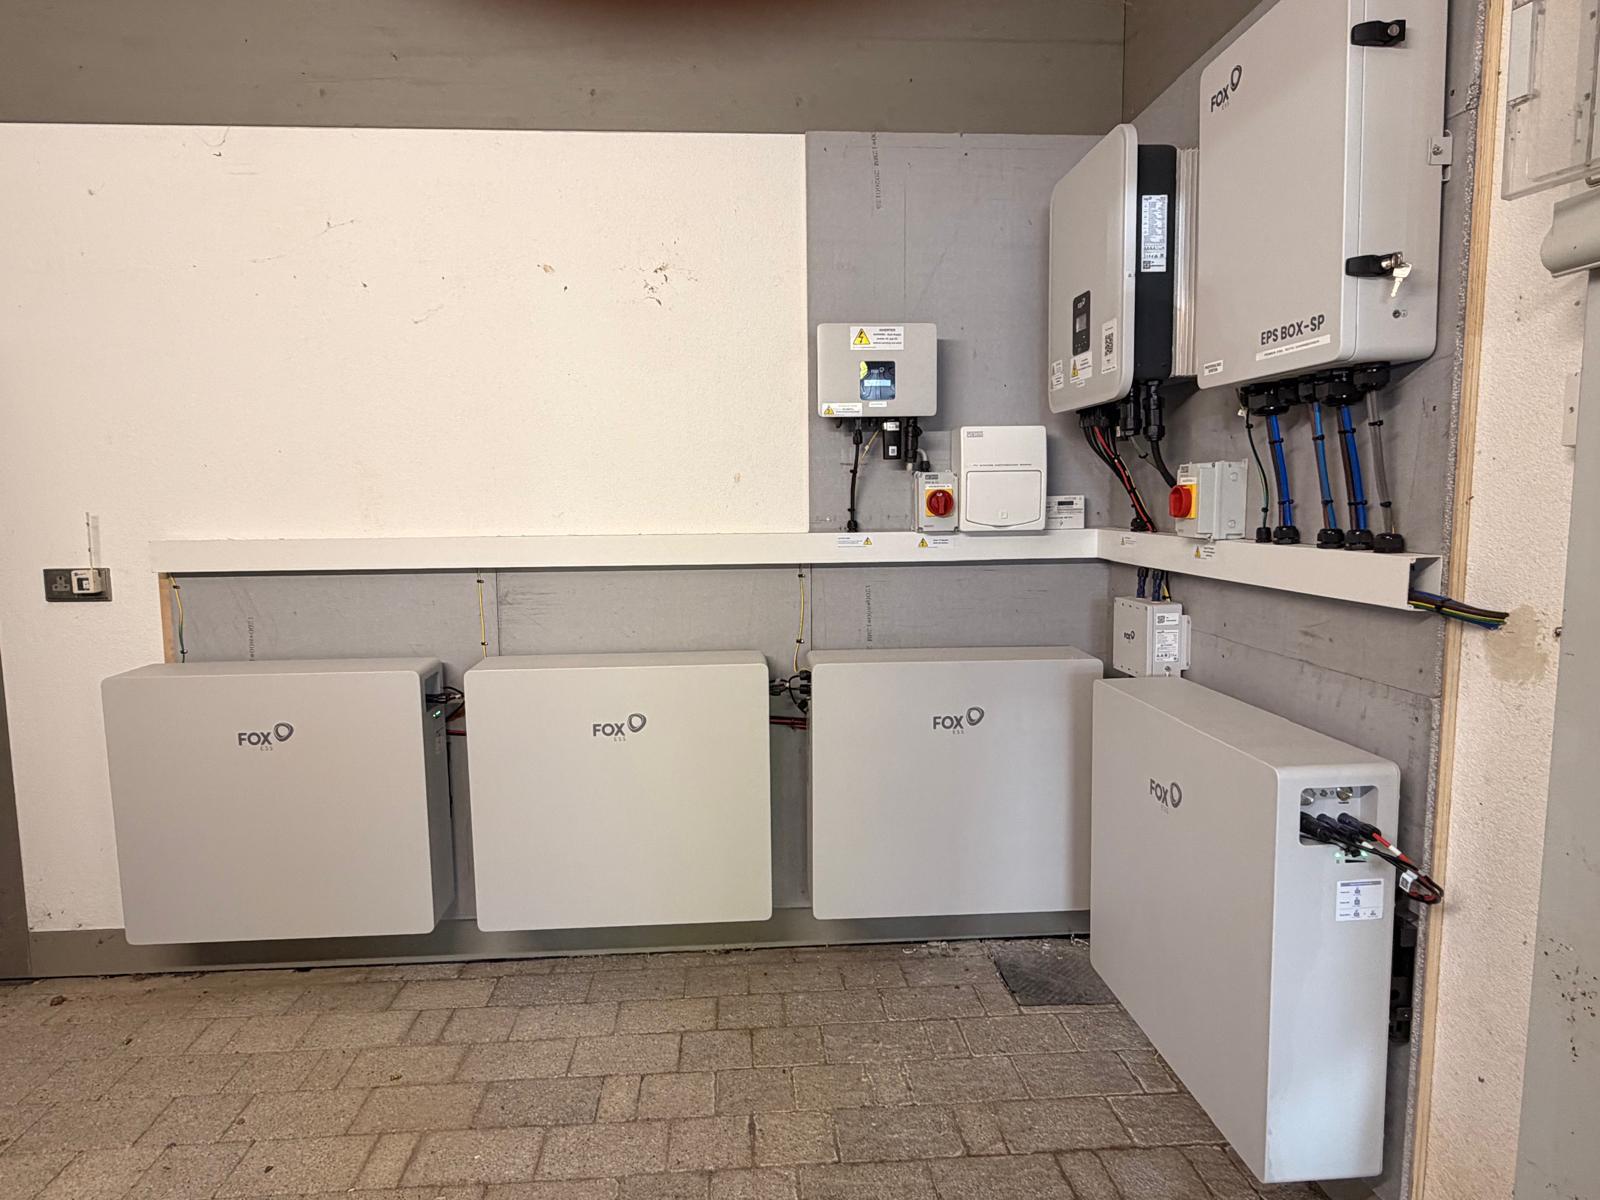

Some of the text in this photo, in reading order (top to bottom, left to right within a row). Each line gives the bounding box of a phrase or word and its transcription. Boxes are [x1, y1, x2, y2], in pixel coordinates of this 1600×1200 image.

[1211, 84, 1230, 113] FOX
[1261, 313, 1325, 346] EPS BOX-SP
[592, 722, 625, 737] FOX
[932, 715, 964, 730] FOX
[238, 731, 272, 746] FOX
[1150, 778, 1169, 807] FOX
